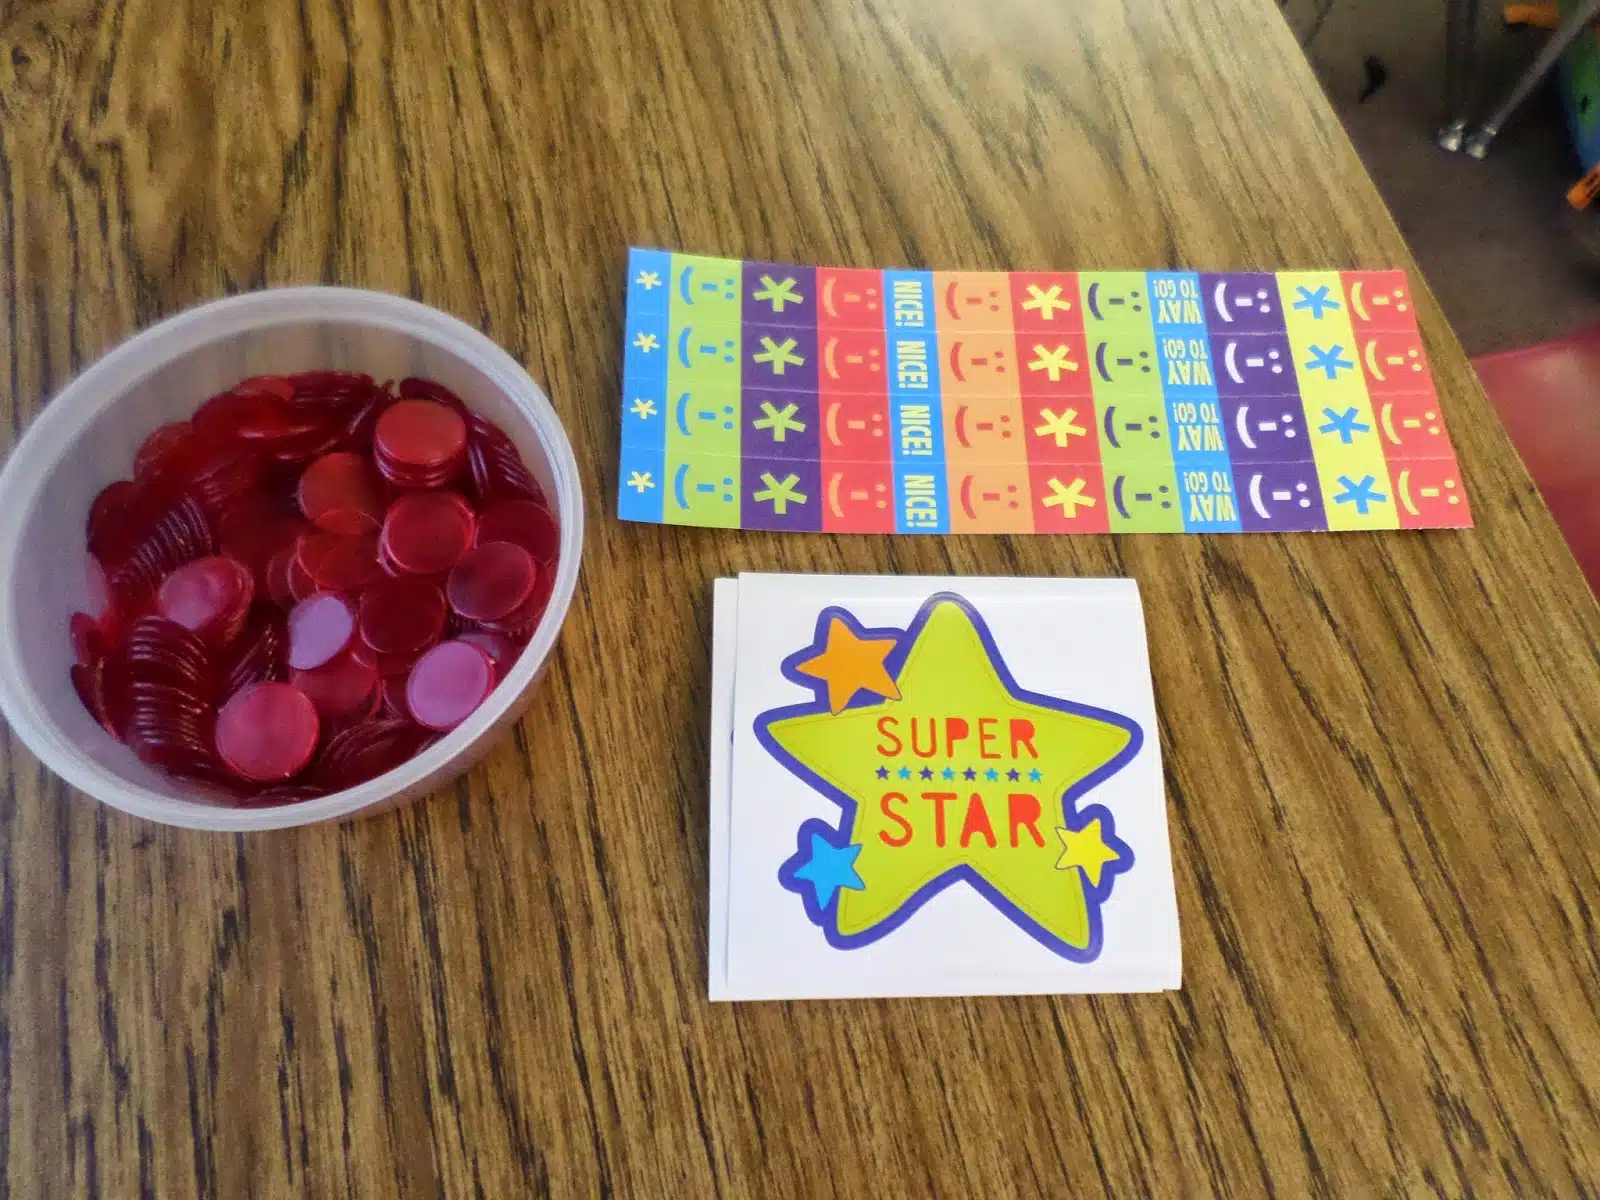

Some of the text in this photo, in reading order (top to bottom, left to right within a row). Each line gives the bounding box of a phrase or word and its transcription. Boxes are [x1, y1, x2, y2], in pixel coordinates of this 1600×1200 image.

[1153, 278, 1199, 299] TO GO!
[893, 280, 925, 328] NICE!
[1158, 299, 1203, 325] WAY
[1162, 338, 1208, 360] TO GO!
[896, 340, 928, 389] NICE!
[1168, 360, 1213, 386] WAY
[1172, 402, 1220, 425] TO GO!
[900, 404, 933, 456] NICE!
[1178, 425, 1224, 451] WAY
[1183, 471, 1232, 495] TO GO!
[904, 474, 938, 528] NICE!
[1189, 494, 1237, 522] WAY
[877, 716, 1038, 759] SUPER
[879, 792, 1045, 848] STAR
